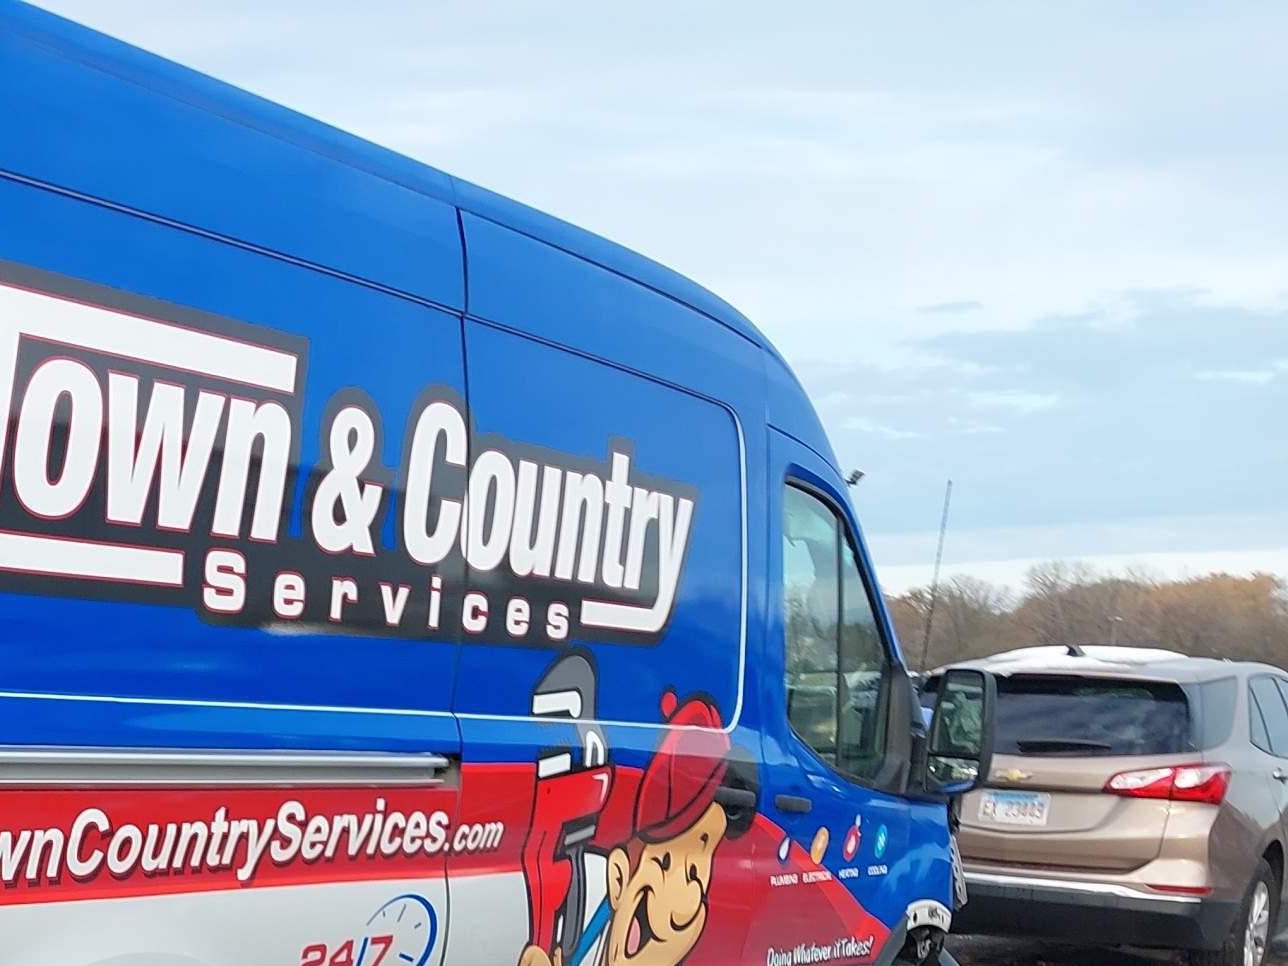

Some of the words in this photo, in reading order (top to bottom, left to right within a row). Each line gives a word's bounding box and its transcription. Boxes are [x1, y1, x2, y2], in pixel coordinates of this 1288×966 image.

[312, 407, 383, 555] &
[403, 401, 694, 632] Country
[202, 549, 570, 640] Services
[793, 944, 832, 964] Whatever
[840, 935, 874, 956] Takes!
